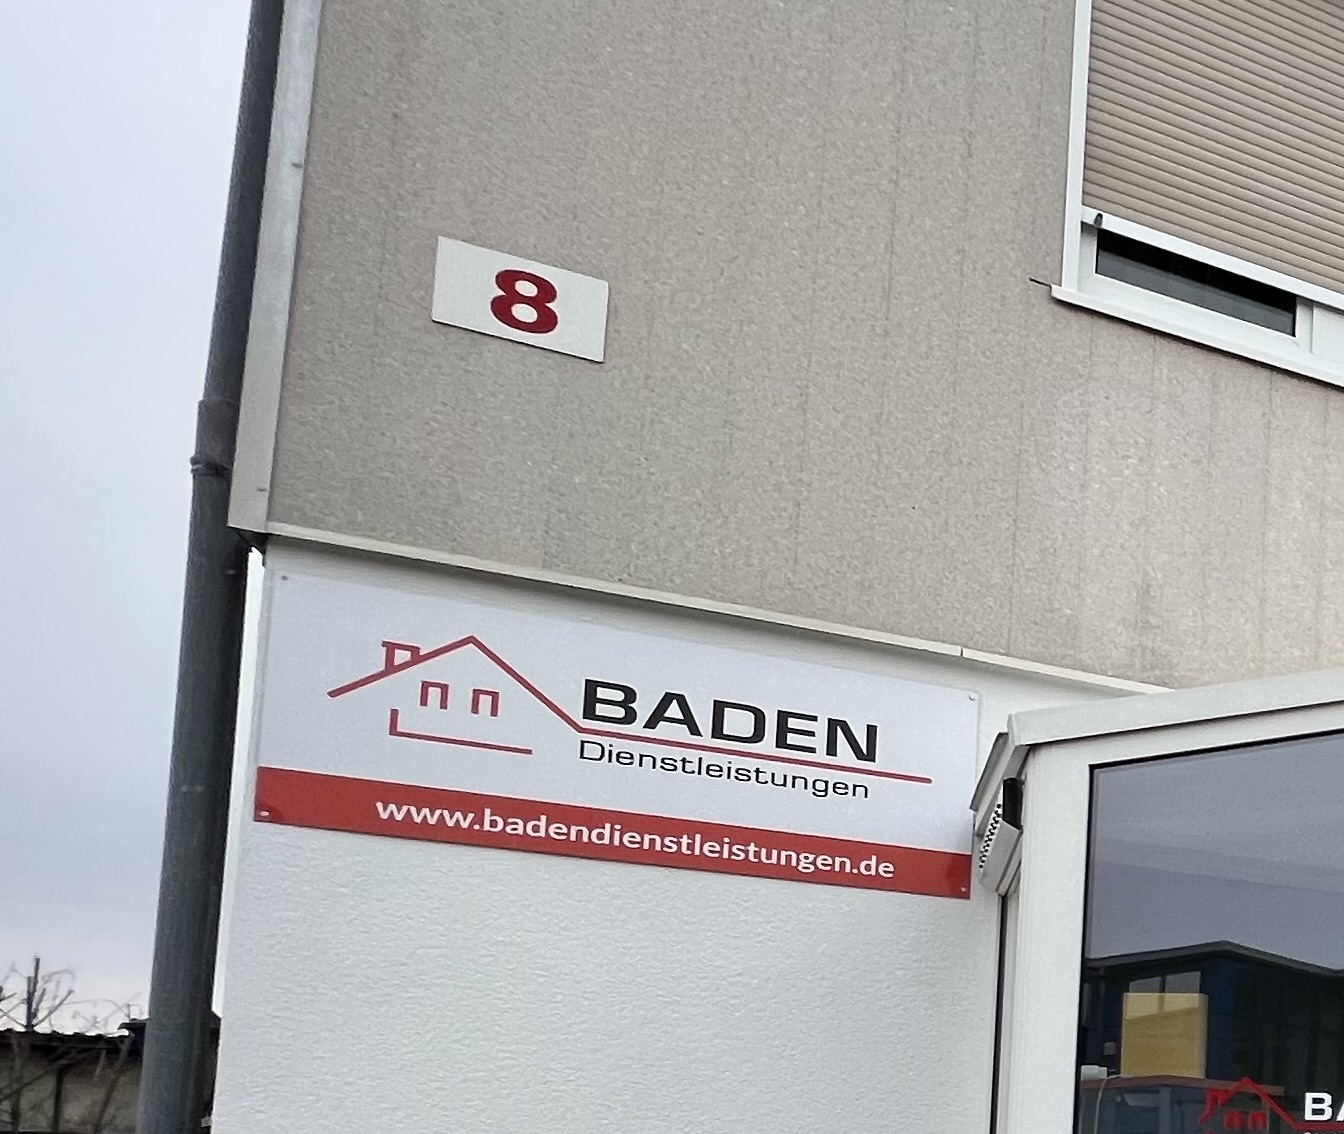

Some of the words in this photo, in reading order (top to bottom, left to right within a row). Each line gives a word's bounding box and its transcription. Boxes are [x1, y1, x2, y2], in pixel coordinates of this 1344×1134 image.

[489, 268, 560, 335] 8
[579, 678, 879, 763] BADEN
[577, 738, 870, 800] Dienstleistungen
[375, 799, 896, 879] www.badendienstleistungen.de
